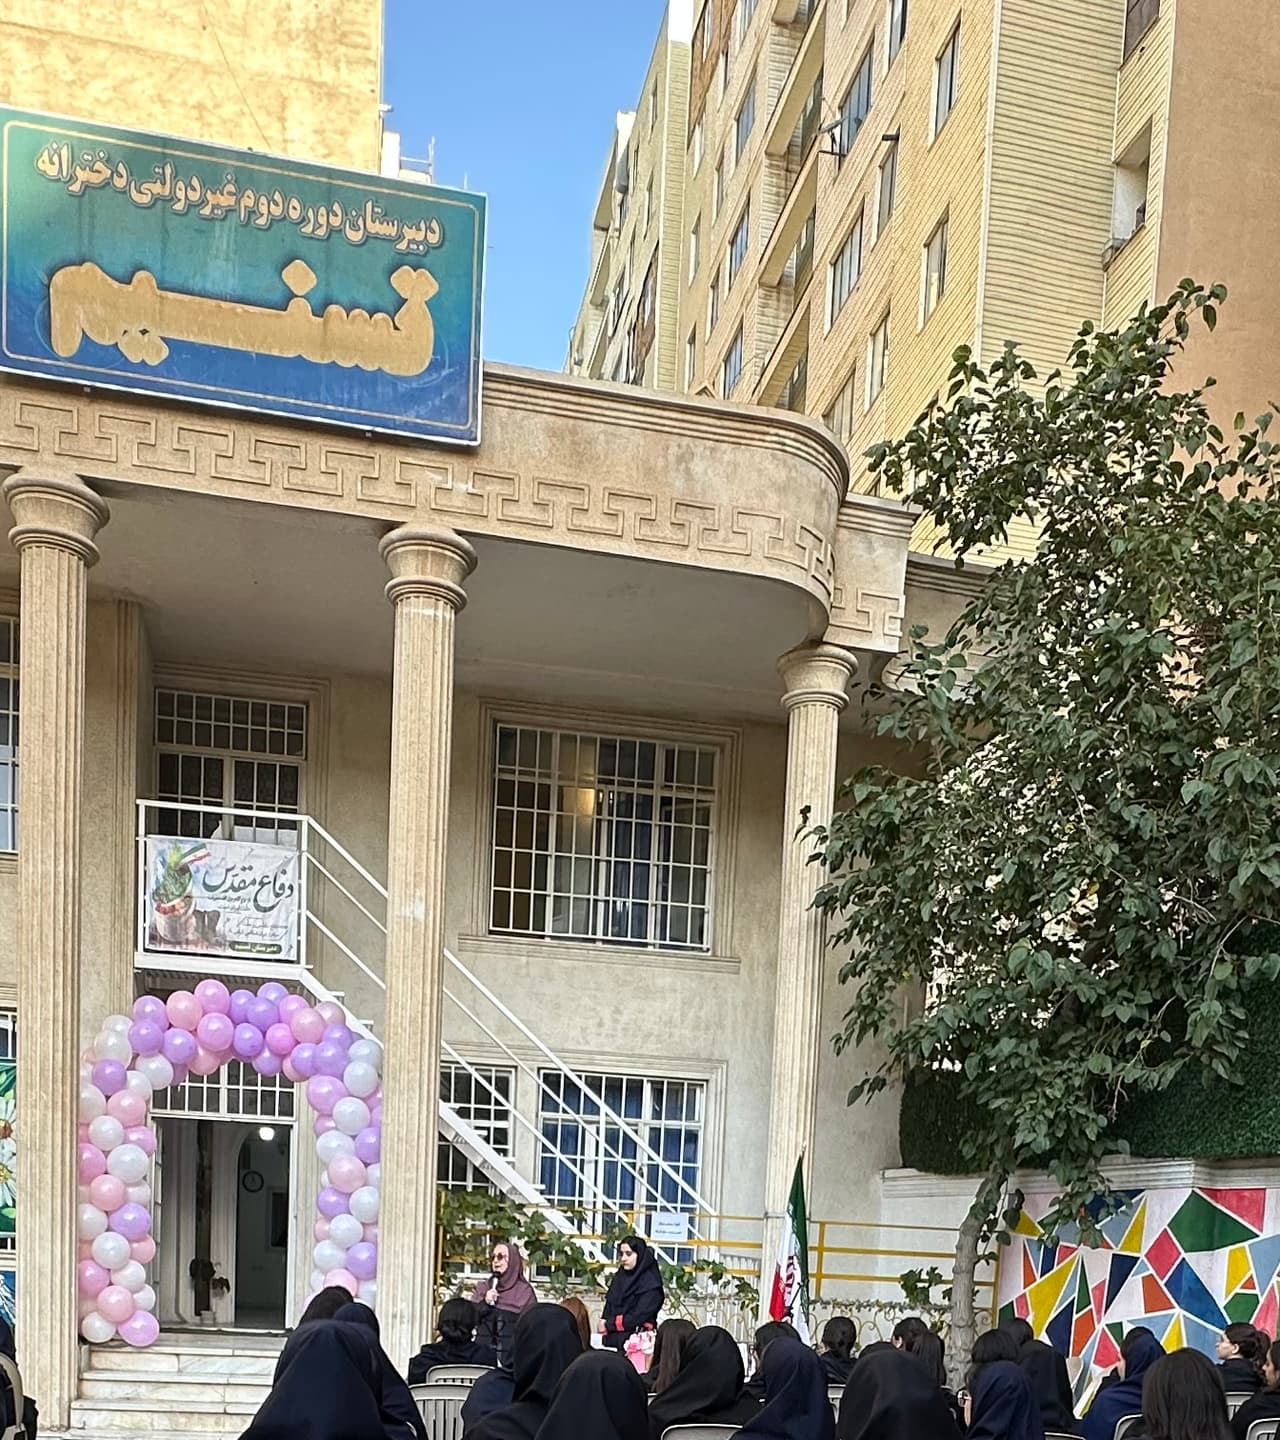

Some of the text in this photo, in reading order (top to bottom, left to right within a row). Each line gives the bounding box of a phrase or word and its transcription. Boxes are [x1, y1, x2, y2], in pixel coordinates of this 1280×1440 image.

[35, 140, 130, 195] دخترانه
[238, 187, 285, 227] دوم
[286, 196, 344, 237] دوره
[344, 199, 442, 252] دبیرستان
[48, 259, 439, 377] تسنیم
[252, 868, 294, 913] دفاع
